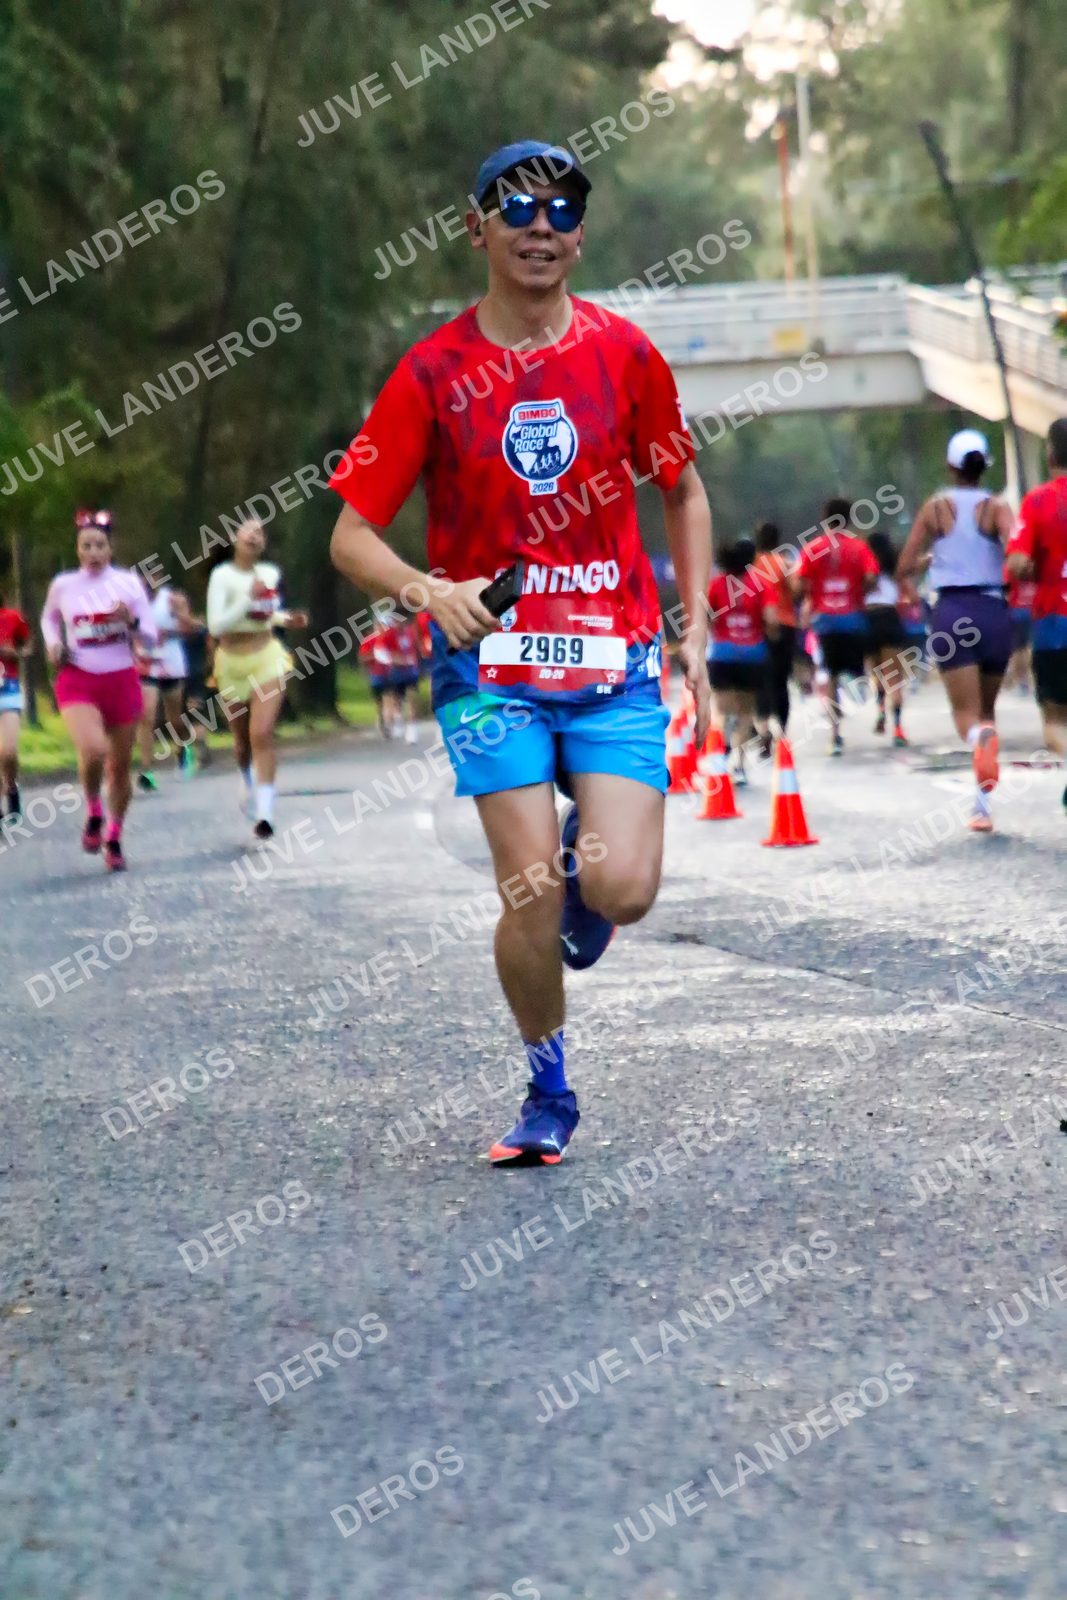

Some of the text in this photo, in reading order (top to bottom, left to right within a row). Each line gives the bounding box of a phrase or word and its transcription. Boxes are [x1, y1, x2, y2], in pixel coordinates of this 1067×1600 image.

[518, 408, 557, 420] BIMBO
[520, 422, 558, 440] Global
[514, 439, 544, 453] Race
[532, 482, 554, 493] 2026
[495, 559, 620, 595] NTIAGO
[520, 635, 584, 665] 2969
